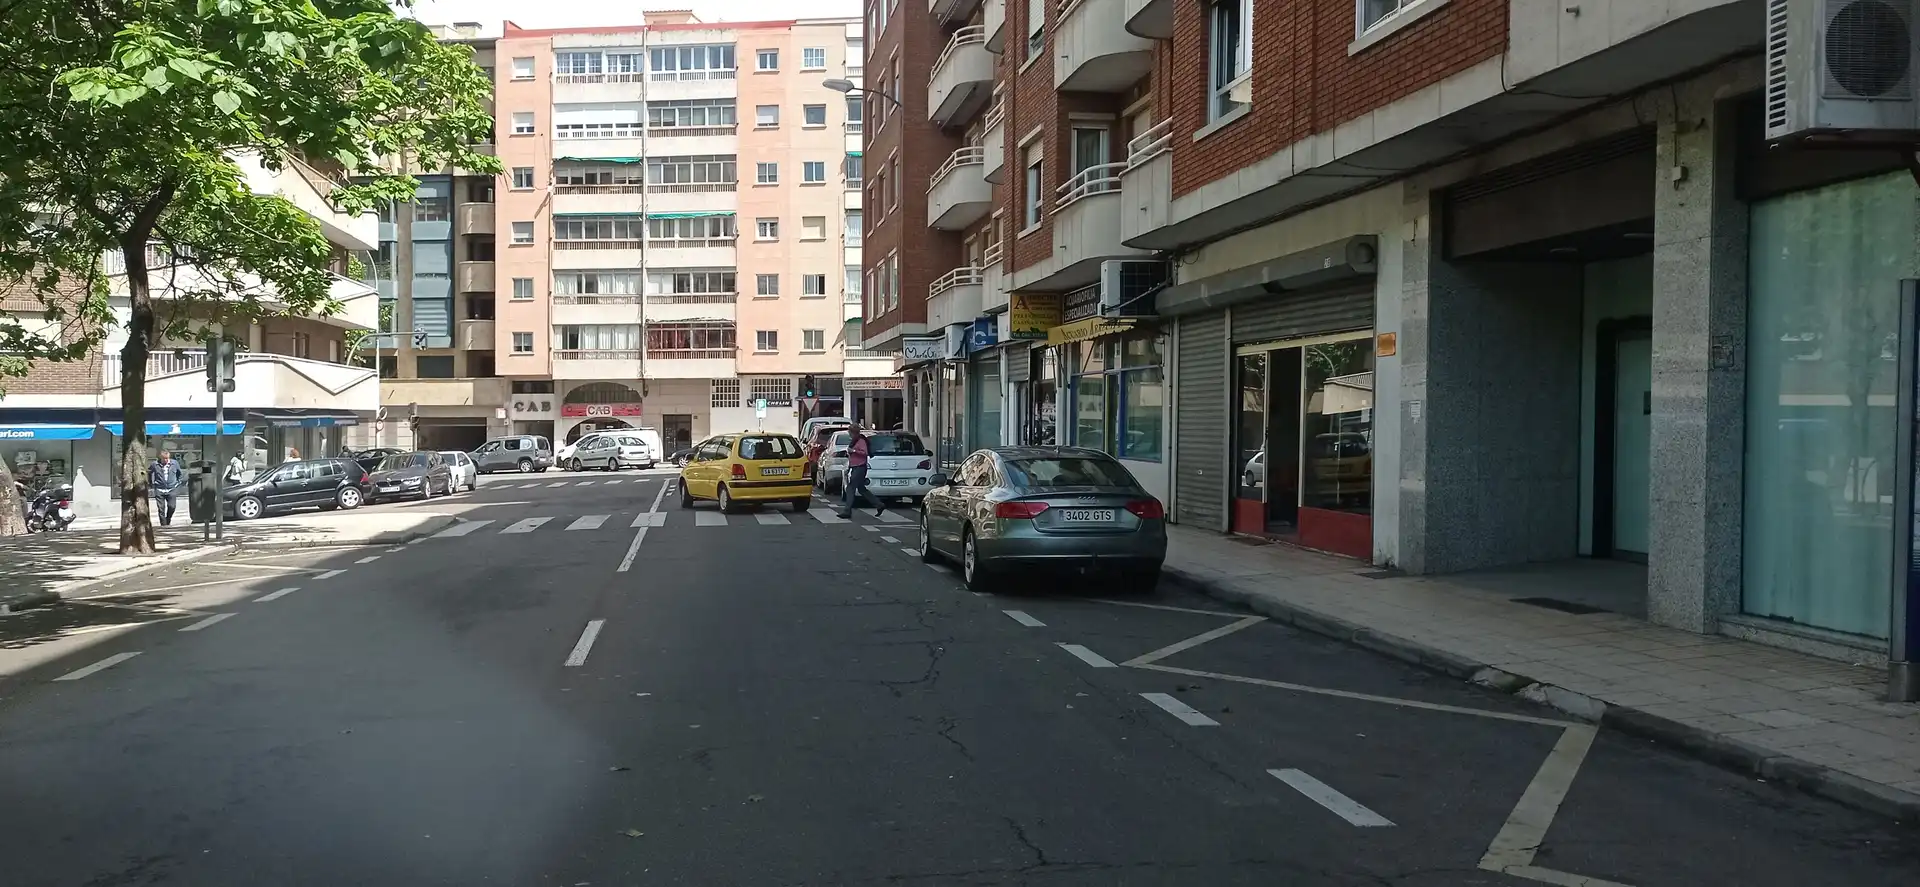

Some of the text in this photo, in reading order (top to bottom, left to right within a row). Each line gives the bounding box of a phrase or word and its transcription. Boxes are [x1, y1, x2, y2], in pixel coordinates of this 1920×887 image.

[514, 401, 551, 412] CAB
[588, 406, 611, 415] CAB
[757, 400, 765, 411] P
[1066, 511, 1111, 520] 3402 GTS
